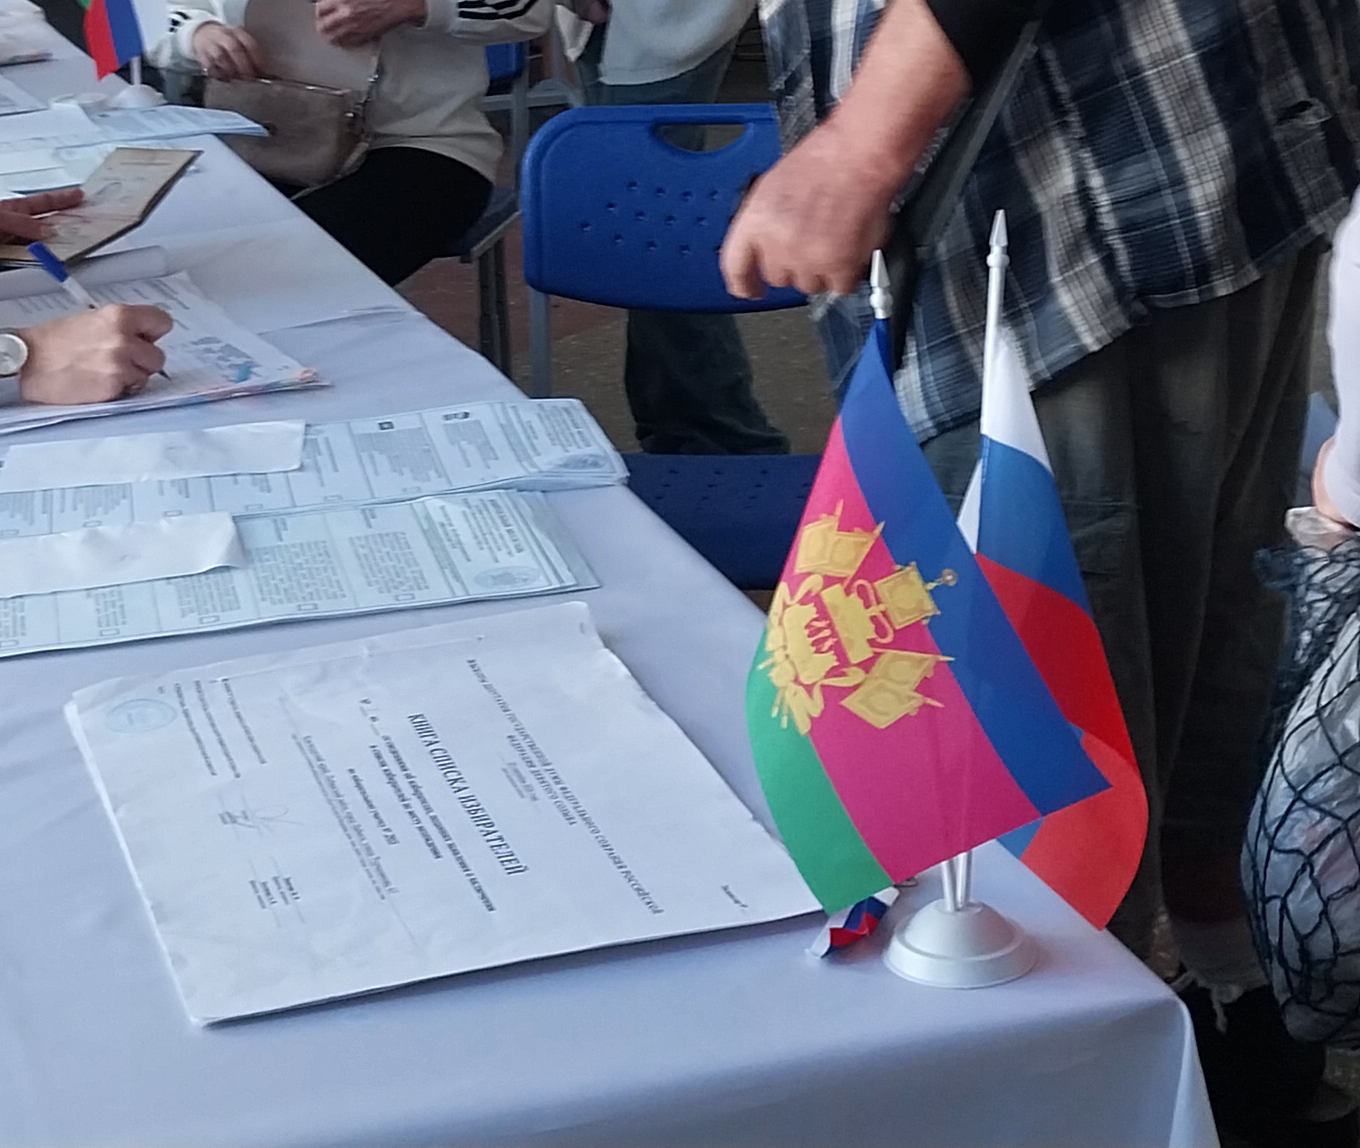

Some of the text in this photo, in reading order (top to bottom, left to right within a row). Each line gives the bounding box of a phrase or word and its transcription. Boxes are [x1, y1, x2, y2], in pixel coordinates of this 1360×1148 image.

[404, 712, 444, 749] КНИГА
[426, 747, 475, 794] СПИСКА
[455, 792, 531, 876] ИЗБИРАТЕЛЕЙ
